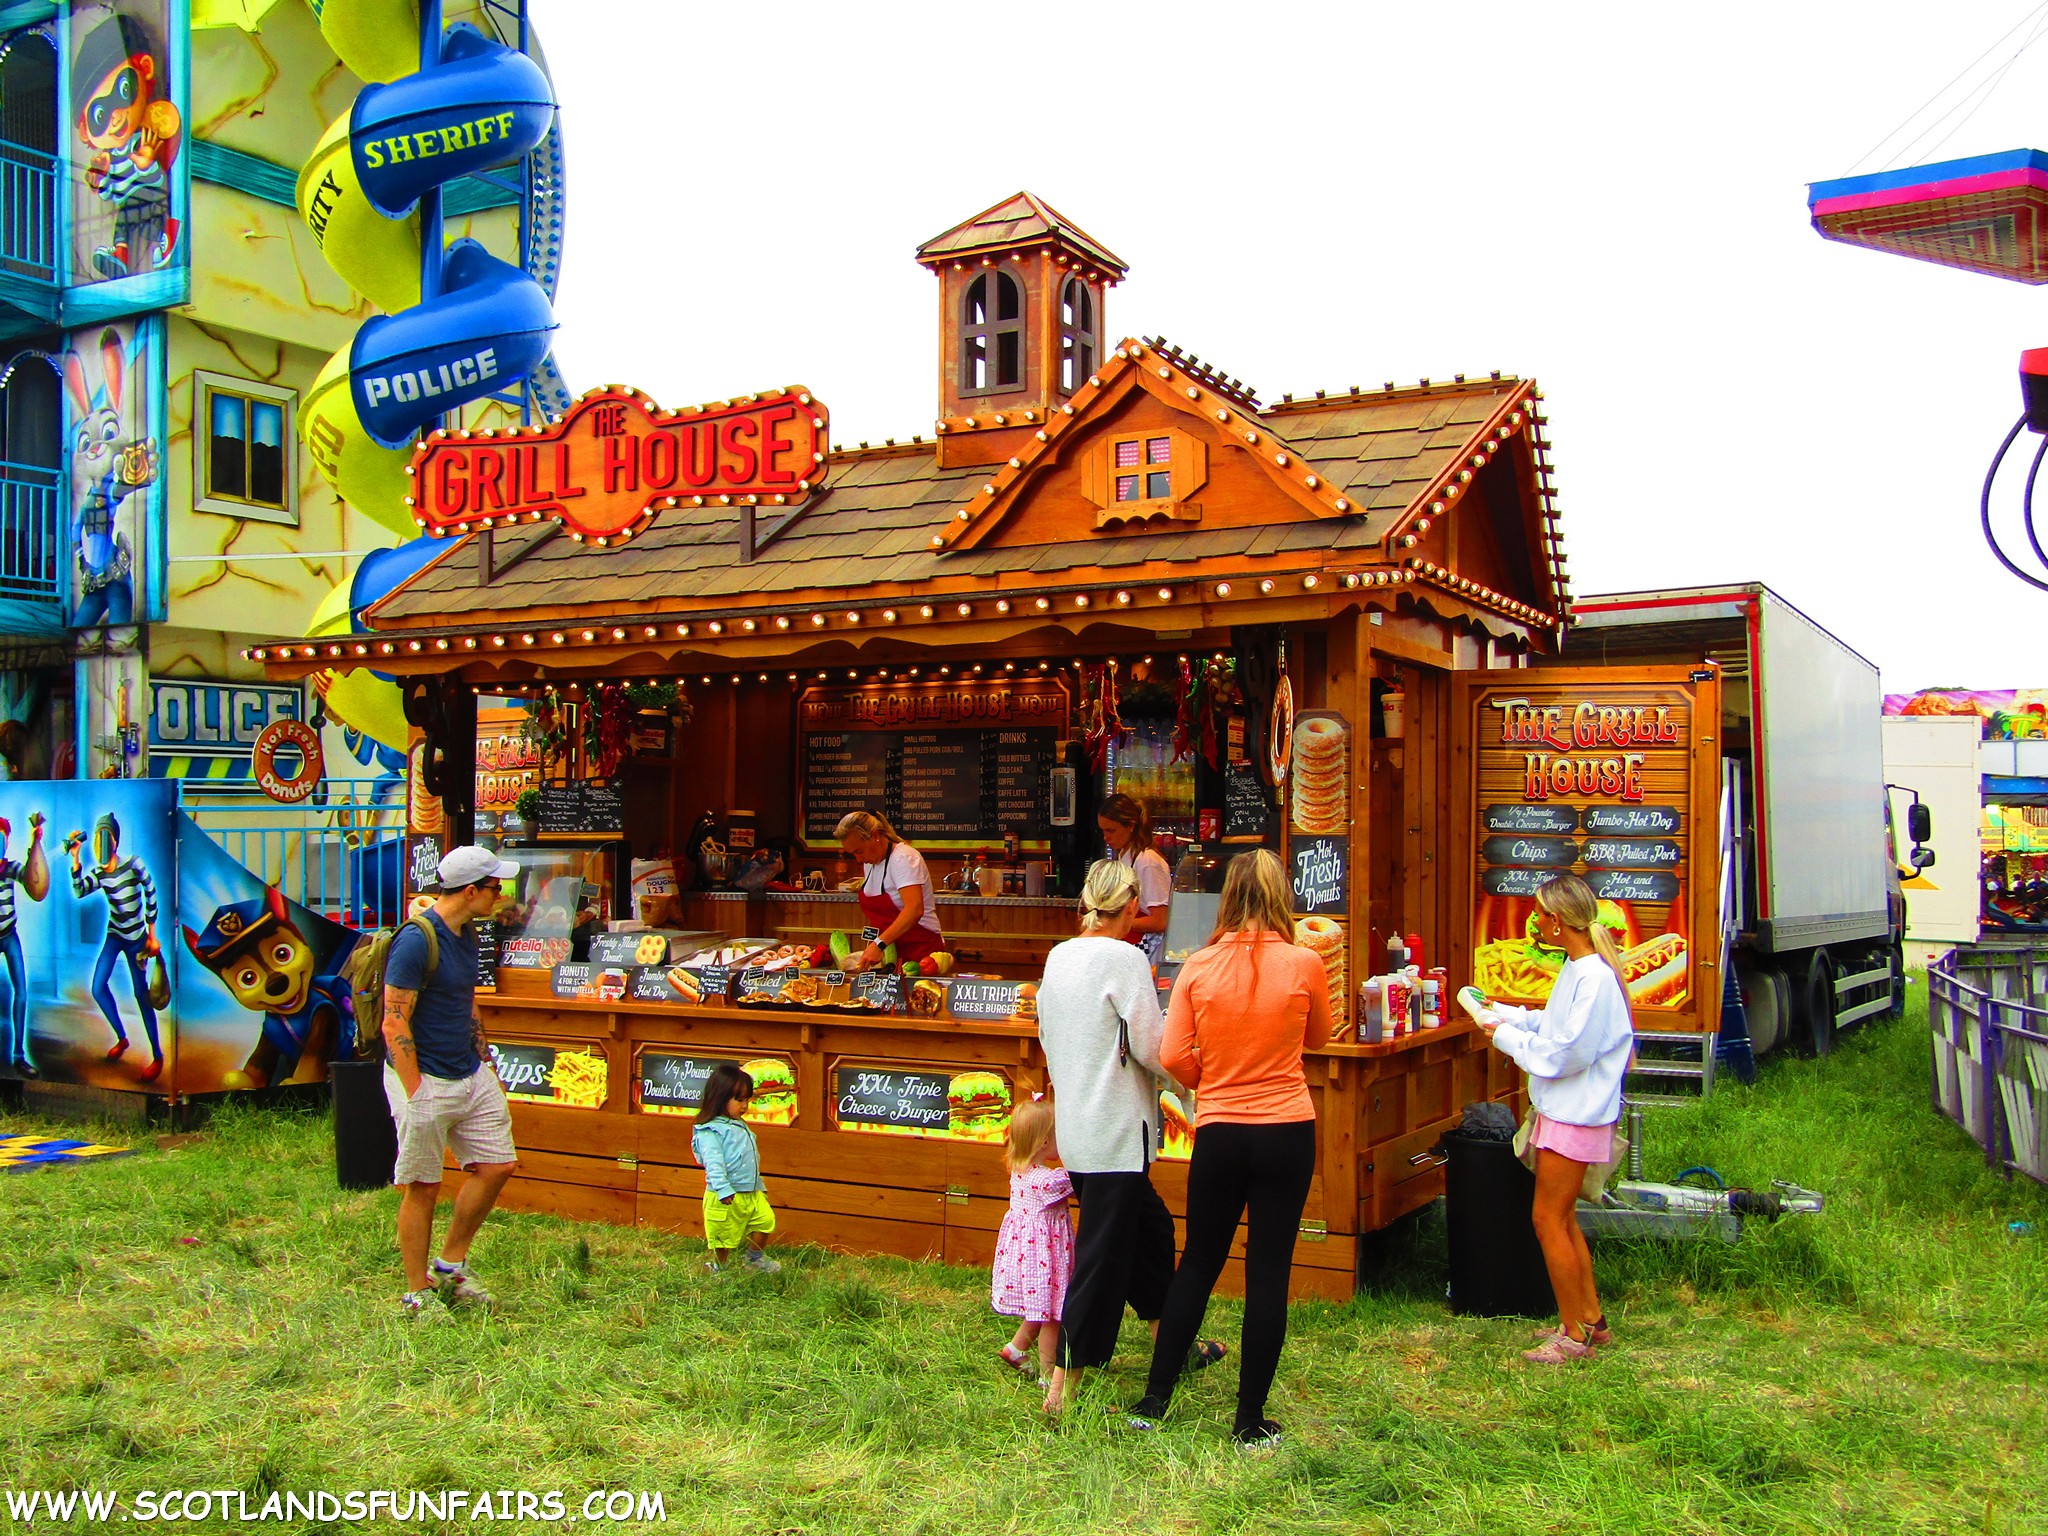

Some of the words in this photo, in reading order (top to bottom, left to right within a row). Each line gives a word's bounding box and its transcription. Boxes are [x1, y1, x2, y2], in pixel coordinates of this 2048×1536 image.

[364, 111, 515, 169] SHERIFF
[309, 169, 343, 251] RITY
[364, 348, 498, 408] POLICE
[589, 405, 626, 437] THE
[435, 443, 585, 516] GRILL
[603, 407, 797, 492] HOUSE
[149, 686, 293, 743] OLICE
[808, 702, 842, 721] MENU
[843, 692, 886, 725] THE
[886, 694, 941, 724] GRILL
[946, 689, 1012, 721] HOUSE
[1018, 695, 1057, 715] MENU
[1492, 697, 1571, 751] THE
[1573, 700, 1679, 748] GRILL
[260, 727, 283, 755] Hot
[287, 724, 319, 761] Fresh
[809, 736, 823, 748] HOT
[823, 736, 841, 748] FOOD
[999, 732, 1028, 744] DRINKS
[998, 754, 1011, 763] COLD
[1010, 754, 1032, 763] BOTTLES
[998, 766, 1011, 774] COLD
[1525, 752, 1645, 801] HOUSE
[261, 772, 314, 799] Donuts
[997, 777, 1016, 786] COFFEE
[1012, 789, 1028, 797] LATTE
[817, 800, 832, 808] TRIPLE
[997, 800, 1008, 809] HOT
[1007, 800, 1036, 809] CHOCOLATE
[1522, 806, 1556, 818] Pounder
[503, 814, 522, 828] Jumbo
[997, 812, 1028, 820] CAPPUCCINO
[1490, 817, 1515, 828] Double
[1516, 819, 1541, 830] Cheese
[1542, 819, 1572, 831] Burger
[1587, 811, 1623, 828] Jumbo
[1623, 811, 1649, 829] Hot
[1650, 812, 1673, 830] Dog
[903, 823, 912, 832] HOT
[912, 823, 927, 832] FRESH
[927, 823, 945, 832] DONUTS
[957, 823, 978, 832] NUTELLA
[997, 823, 1008, 832] TEA
[1313, 839, 1333, 864] Hot
[1511, 840, 1548, 862] Chips
[1584, 843, 1615, 863] BBQ
[1616, 844, 1649, 862] Pulled
[1650, 845, 1676, 863] Pork
[410, 843, 440, 880] Fresh
[1293, 849, 1343, 897] Fresh
[1503, 870, 1529, 882] XXL
[1605, 872, 1631, 886] Hot
[1633, 875, 1653, 886] and
[1497, 882, 1526, 893] Cheese
[1598, 885, 1623, 899] Cold
[1625, 886, 1659, 900] Drinks
[1305, 883, 1341, 912] Donuts
[502, 937, 543, 953] nutella
[592, 934, 618, 952] Freshly
[618, 935, 640, 951] Made
[504, 952, 536, 966] Donuts
[601, 949, 624, 963] Donuts
[559, 965, 590, 977] DONUTS
[639, 967, 665, 983] Jumbo
[558, 977, 562, 985] 4
[562, 977, 573, 985] FOR
[557, 985, 571, 993] WITH
[571, 985, 594, 994] NUTELLA
[636, 984, 651, 1000] Hot
[652, 986, 668, 1001] Dog
[954, 984, 978, 1000] XXL
[981, 985, 1022, 1003] TRIPLE
[953, 1001, 984, 1014] CHEESE
[985, 1002, 1019, 1015] BURGER
[664, 1059, 681, 1080] 1/4
[644, 1079, 672, 1098] Double
[673, 1081, 701, 1101] Cheese
[850, 1072, 893, 1097] XXL
[898, 1075, 942, 1098] Triple
[838, 1095, 887, 1117] Cheese
[890, 1096, 948, 1125] Burger
